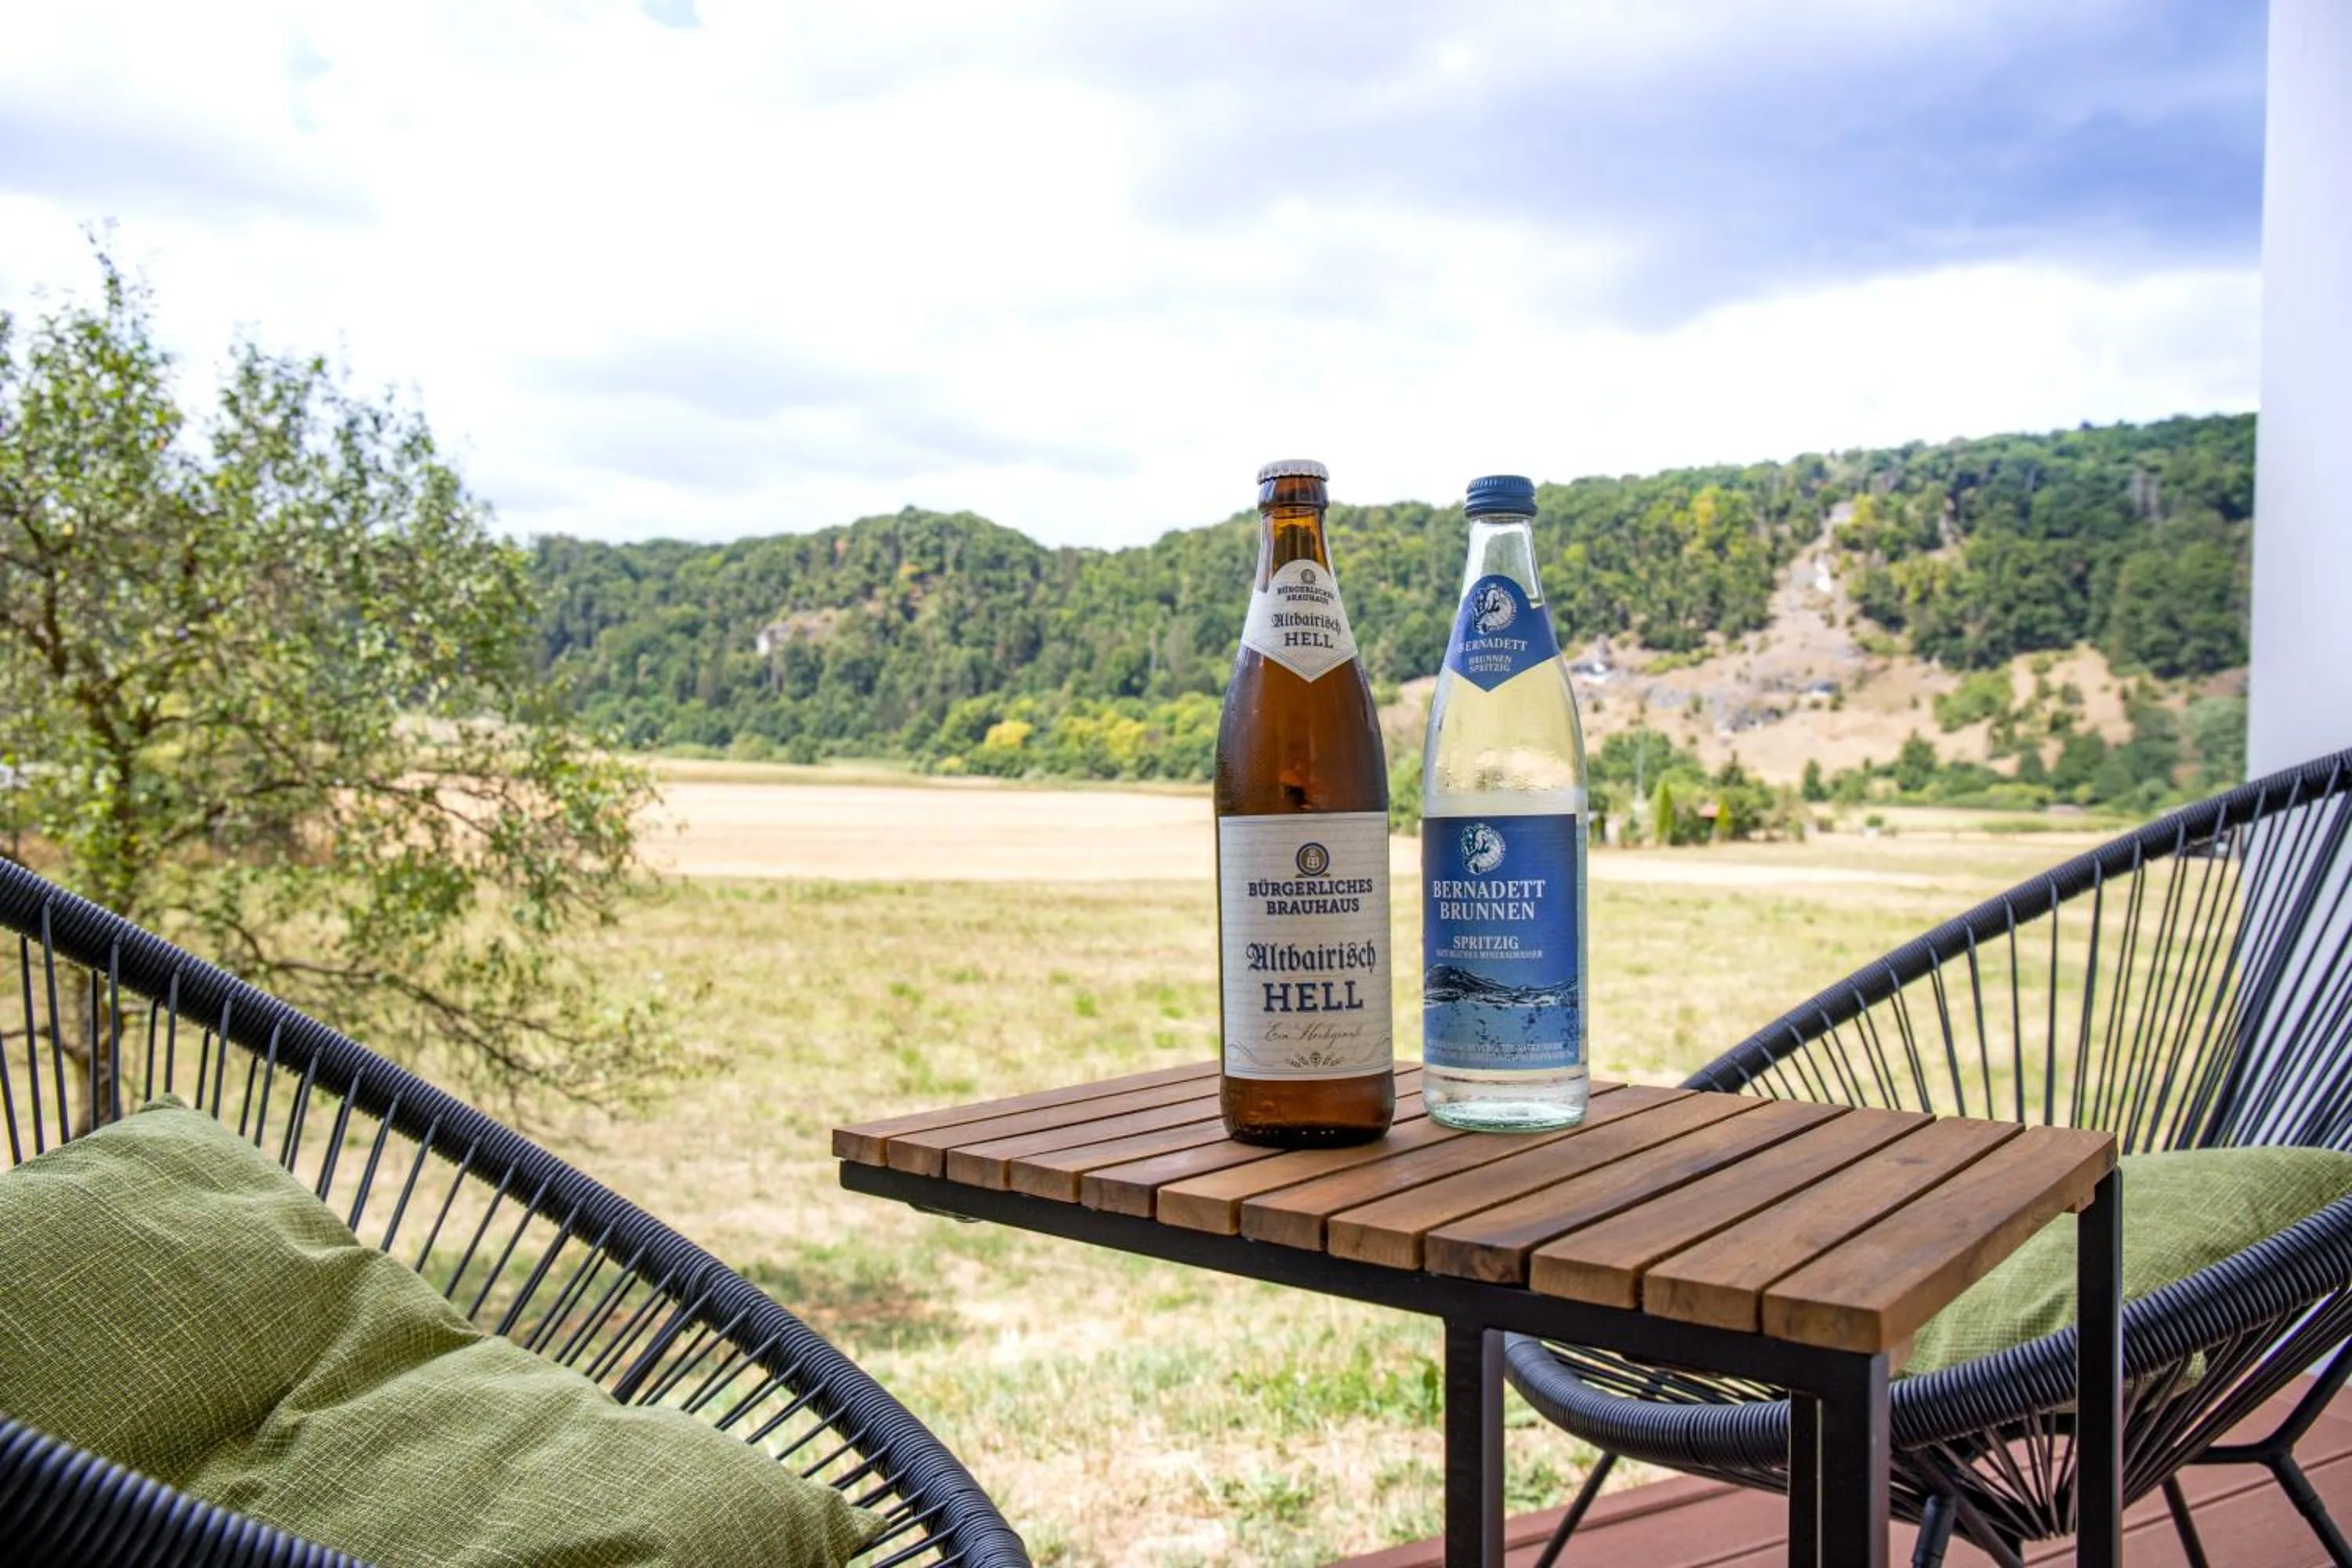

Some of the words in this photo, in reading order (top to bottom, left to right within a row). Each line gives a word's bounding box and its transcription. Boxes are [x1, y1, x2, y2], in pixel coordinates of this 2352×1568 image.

[1272, 612, 1341, 637] Altbairisch
[1284, 632, 1334, 648] HELL
[1248, 878, 1373, 897] BÜRGERLICHES
[1433, 879, 1545, 898] BERNADETT
[1266, 898, 1360, 916] BRAUHAUS
[1440, 902, 1536, 920] BRUNNEN
[1453, 935, 1519, 949] SPRITZIG
[1246, 940, 1376, 974] Altbairisch
[1262, 981, 1363, 1013] HELL
